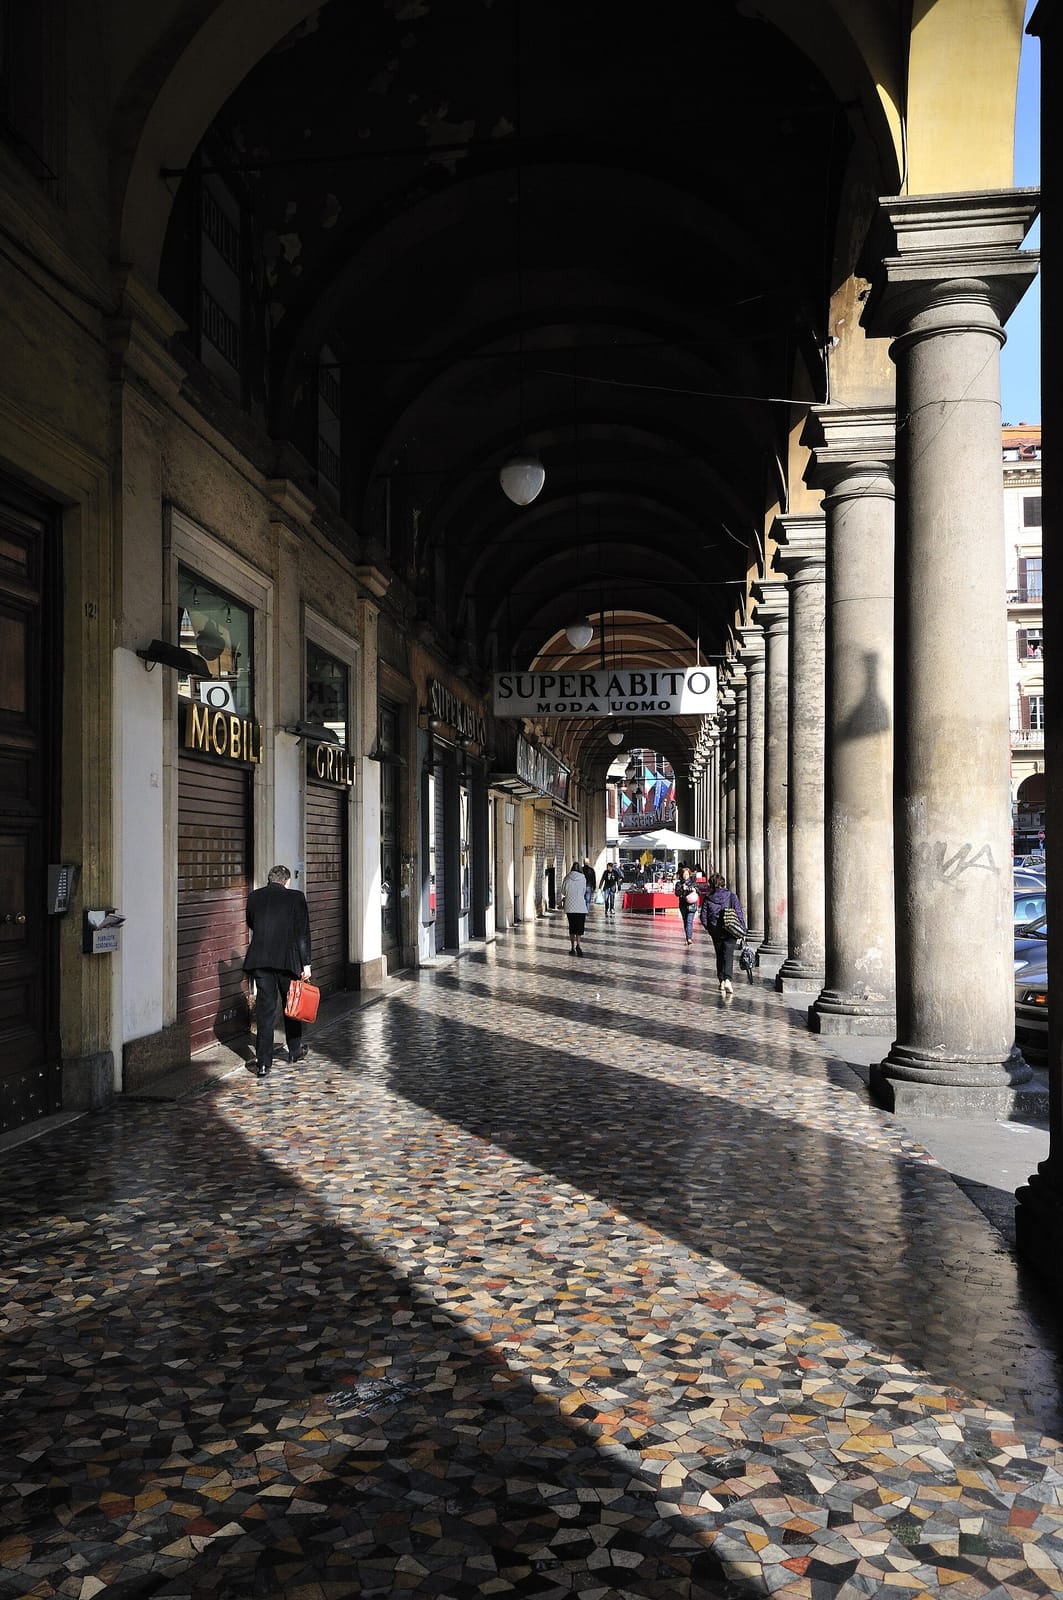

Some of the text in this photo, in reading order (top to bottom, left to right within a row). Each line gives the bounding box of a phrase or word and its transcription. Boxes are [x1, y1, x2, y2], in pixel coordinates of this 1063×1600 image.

[498, 671, 711, 699] SUPERABITO
[536, 700, 671, 713] MODA UOMO
[186, 703, 263, 764] MOBILI
